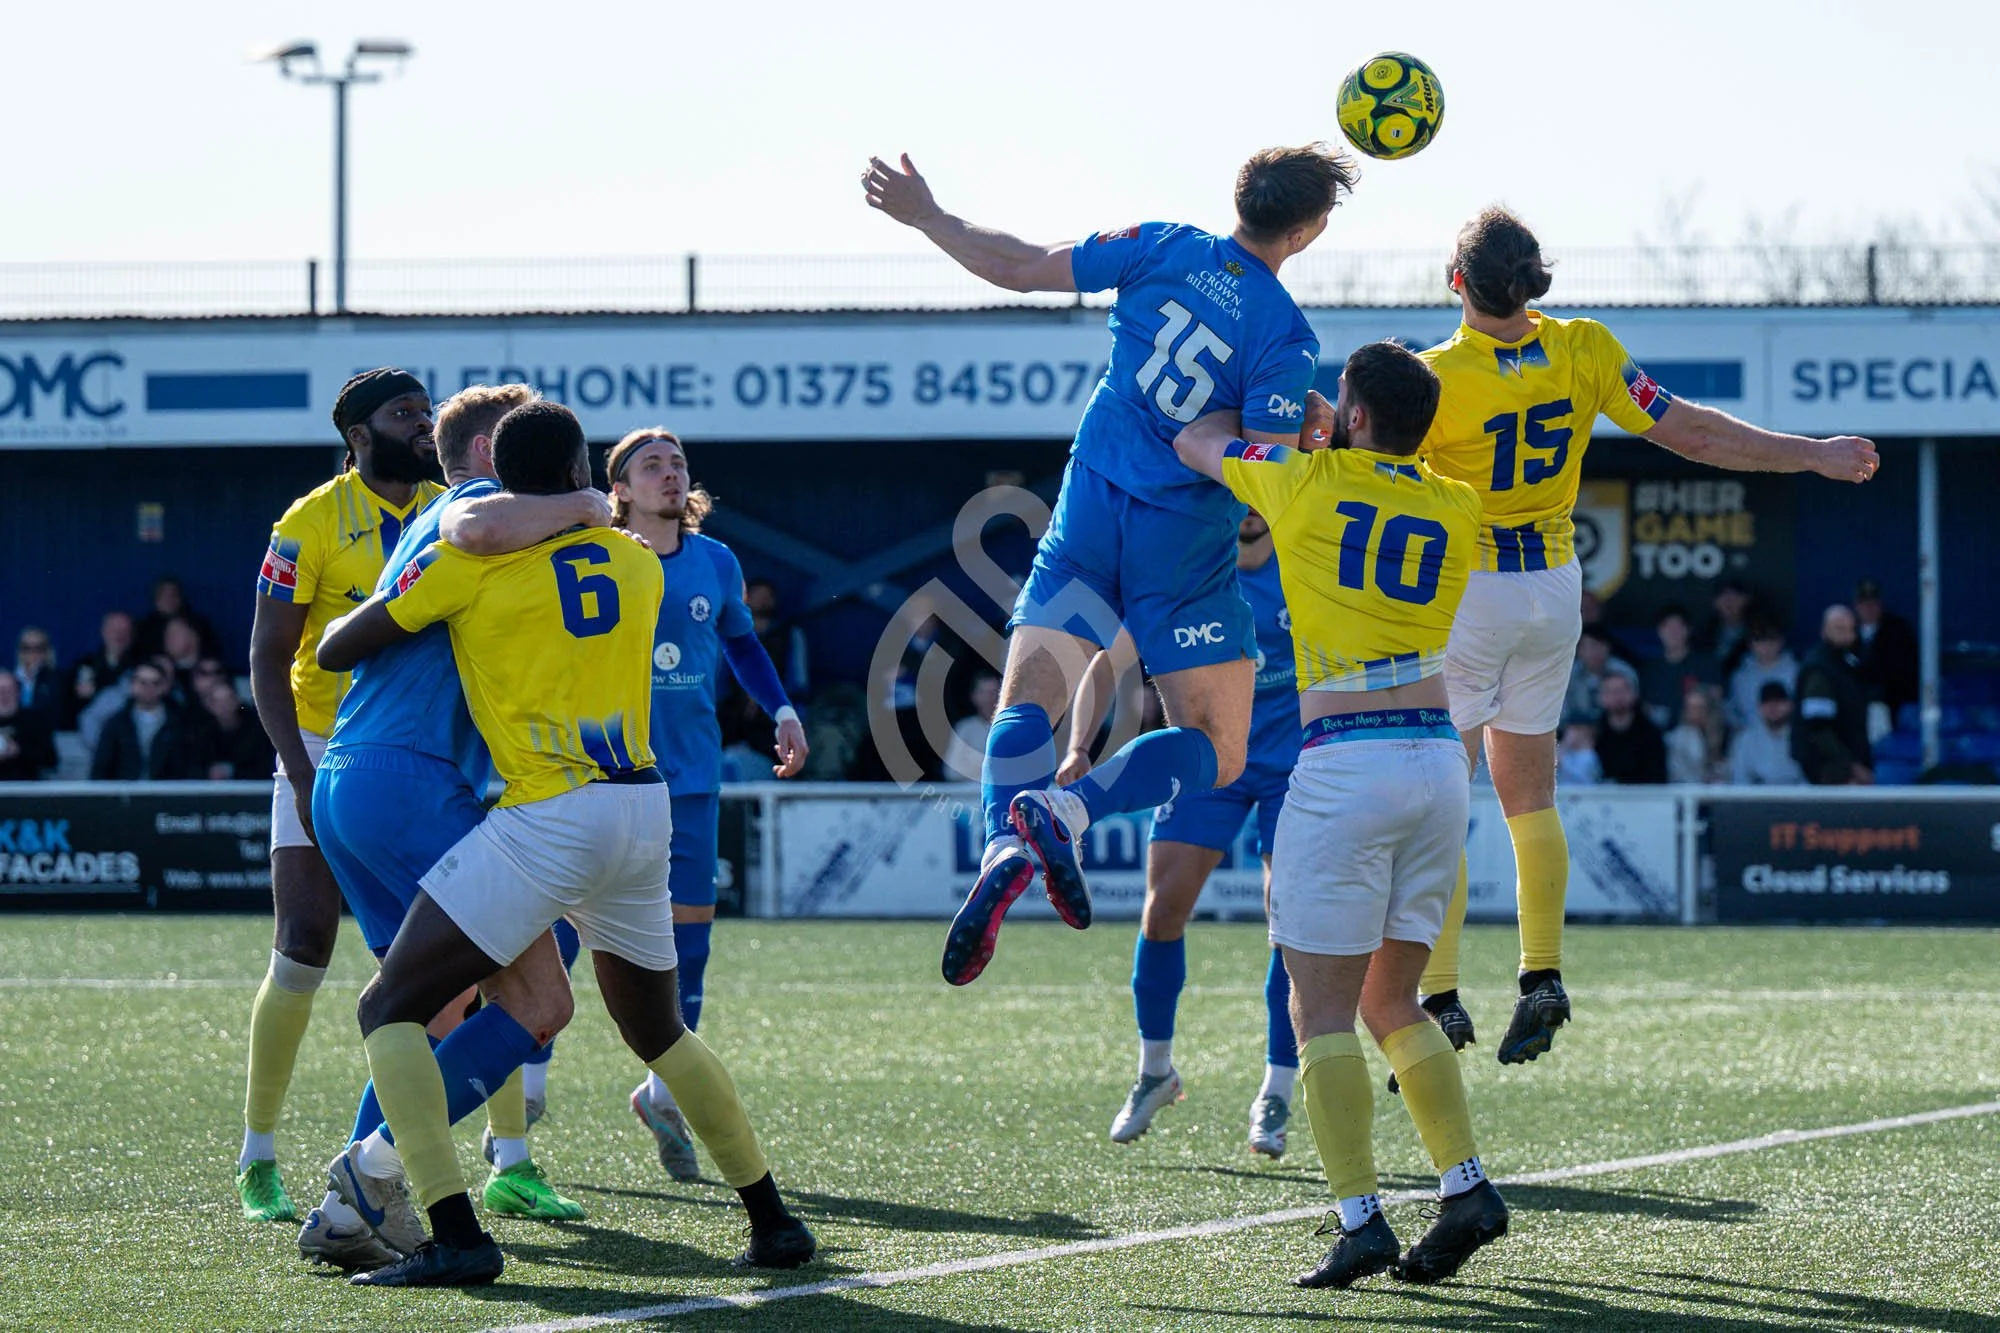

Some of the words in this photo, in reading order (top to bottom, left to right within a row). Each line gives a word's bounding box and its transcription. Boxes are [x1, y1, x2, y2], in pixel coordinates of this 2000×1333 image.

[1186, 272, 1243, 320] BILLERICAY
[1200, 270, 1242, 306] CROWN
[1216, 269, 1240, 290] THE
[1135, 298, 1234, 424] 15
[733, 362, 891, 407] 01375
[914, 361, 1105, 406] 84507
[1791, 358, 1999, 402] SPECIA
[1483, 399, 1574, 491] 15
[1634, 511, 1754, 546] GAME
[1335, 500, 1449, 606] 10
[1633, 543, 1724, 580] TOO
[550, 542, 620, 639] 6
[1174, 622, 1225, 648] DMC
[1322, 717, 1344, 732] Rick
[1770, 822, 1798, 850] IT
[1803, 823, 1921, 857] Support
[1741, 864, 1828, 894] Cloud
[1830, 864, 1950, 894] Services
